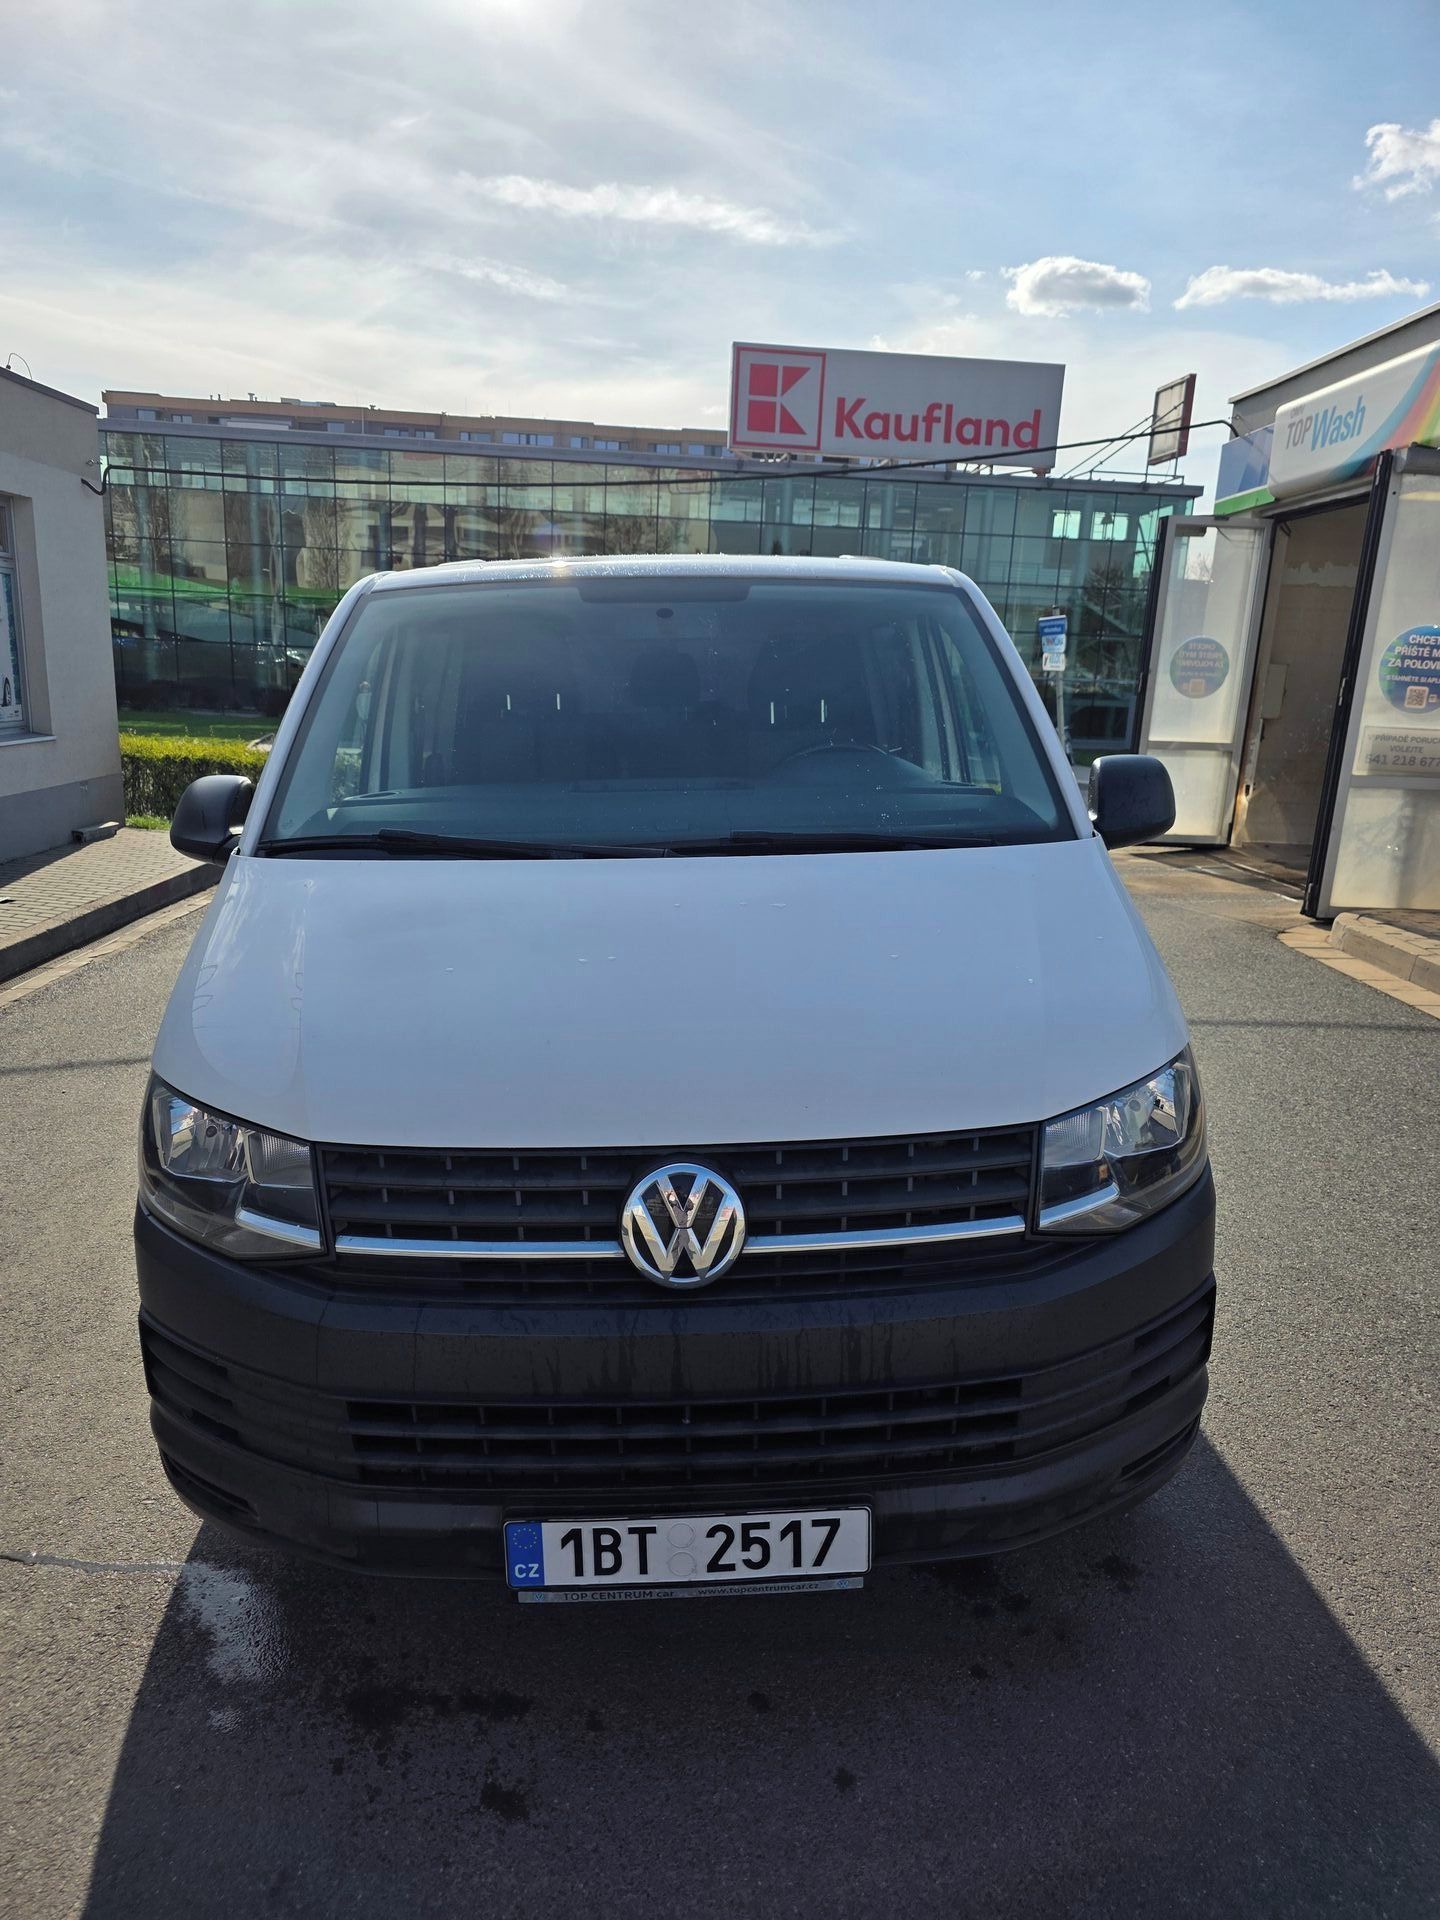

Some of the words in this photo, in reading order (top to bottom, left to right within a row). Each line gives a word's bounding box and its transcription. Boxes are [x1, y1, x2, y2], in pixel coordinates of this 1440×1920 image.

[834, 396, 1042, 449] Kaufland
[1388, 658, 1402, 668] ZA
[1391, 755, 1417, 766] 218
[560, 1525, 657, 1577] 1BT
[705, 1517, 841, 1574] 2517
[513, 1563, 540, 1579] CZ
[698, 1582, 819, 1595] www.topcentrumcar.cz
[563, 1592, 588, 1601] TOP
[591, 1590, 653, 1600] CENTRUM
[656, 1590, 675, 1598] car
